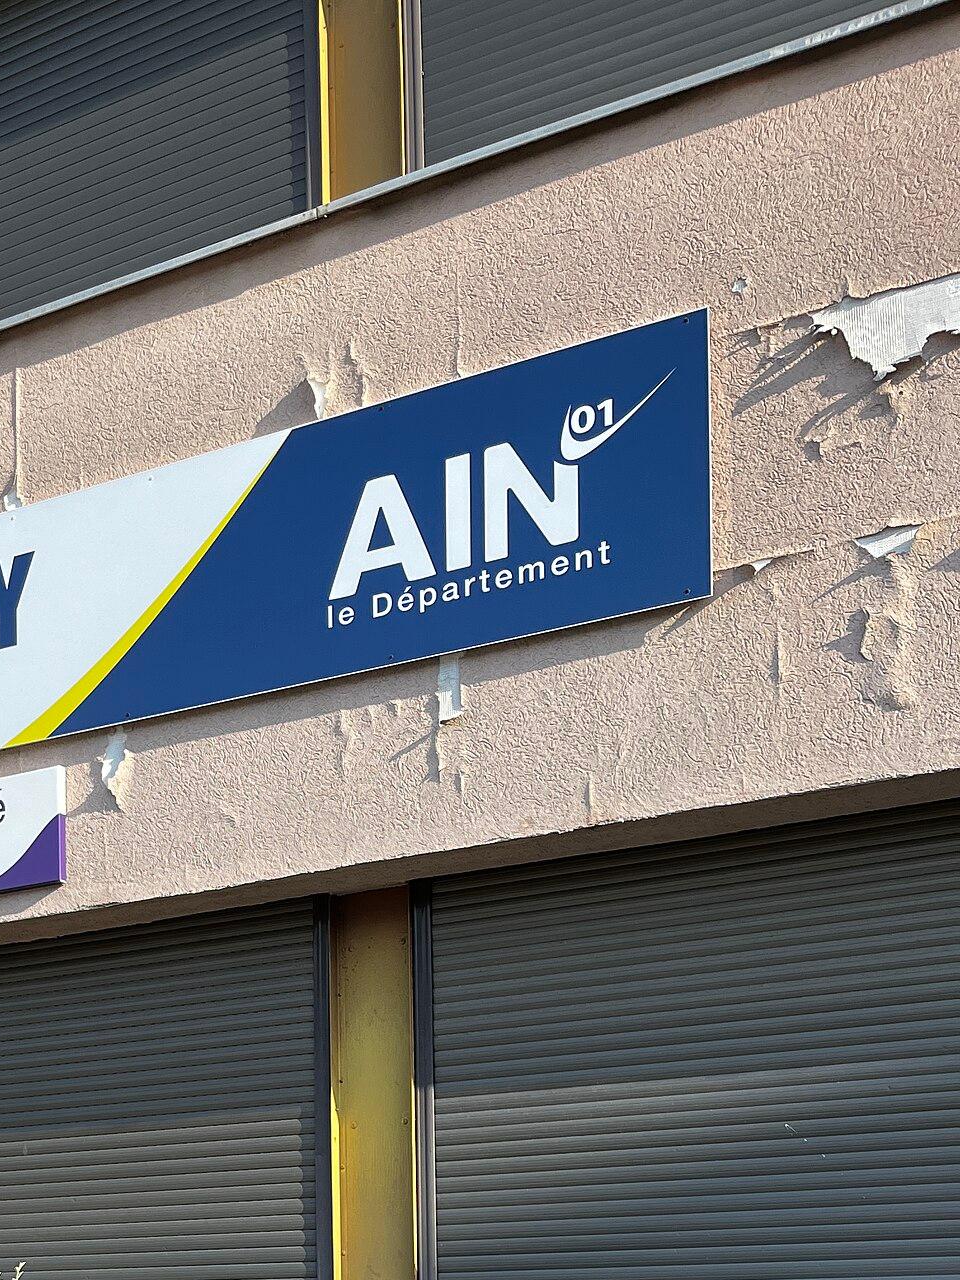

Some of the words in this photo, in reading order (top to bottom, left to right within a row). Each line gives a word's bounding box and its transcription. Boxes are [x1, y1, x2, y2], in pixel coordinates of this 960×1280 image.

[570, 398, 614, 434] 01
[328, 442, 580, 601] AIN
[327, 604, 355, 629] le
[372, 540, 612, 619] Département
